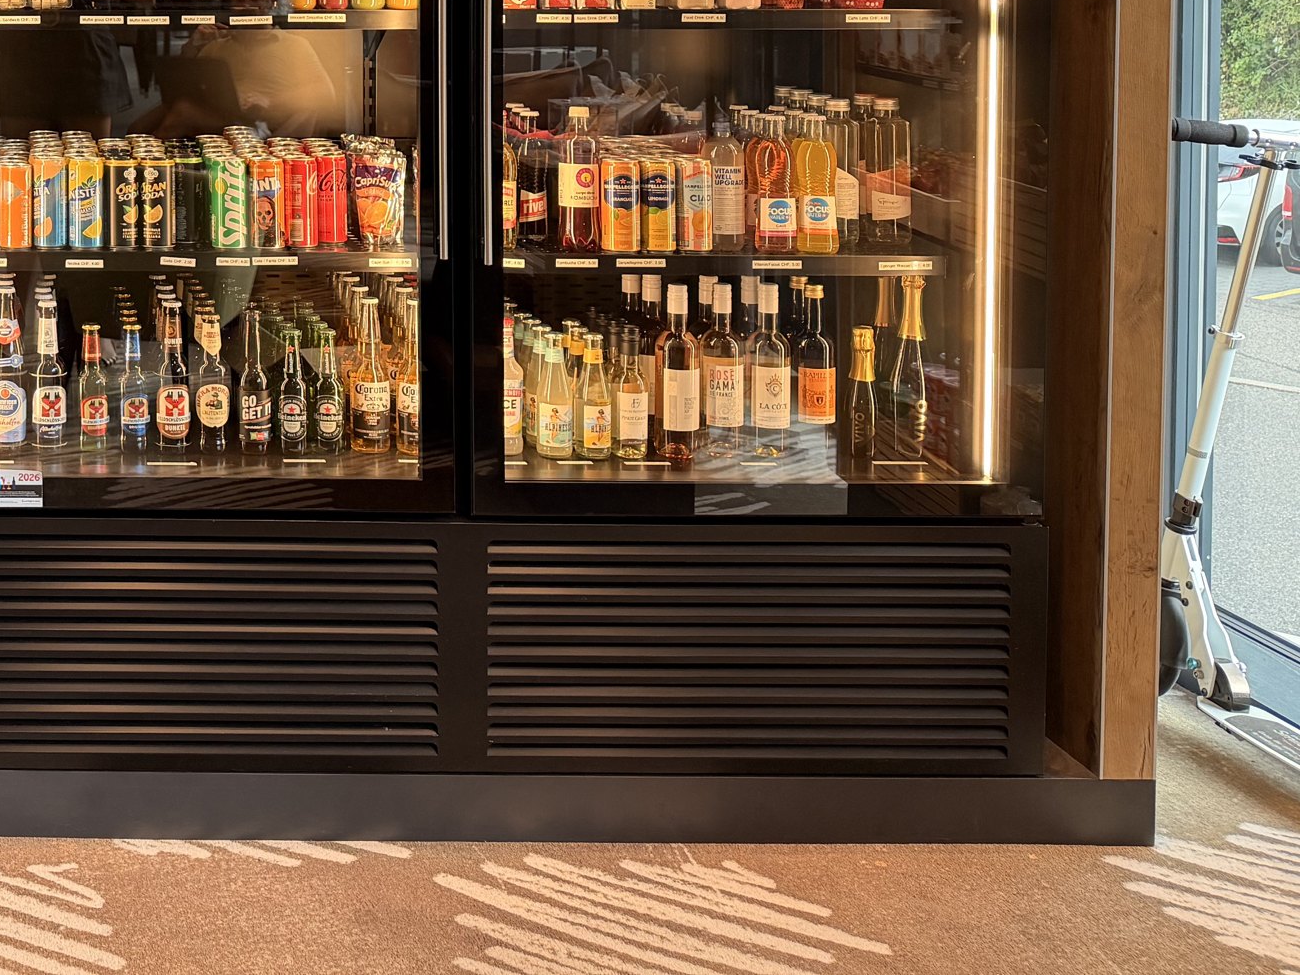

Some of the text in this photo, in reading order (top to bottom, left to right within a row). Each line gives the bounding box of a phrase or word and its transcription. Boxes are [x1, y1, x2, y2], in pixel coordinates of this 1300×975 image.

[69, 188, 101, 200] NESTEA
[115, 182, 138, 195] ORA
[118, 191, 139, 202] SOD
[141, 191, 165, 200] SODA
[220, 159, 247, 245] Sprite
[710, 368, 735, 381] ROSÉ
[355, 383, 389, 395] Corona
[242, 395, 257, 408] GO
[364, 394, 383, 402] Extra
[503, 399, 517, 409] CE
[242, 406, 263, 420] GET
[915, 400, 928, 442] VIVO
[855, 412, 865, 443] VIVO
[18, 473, 41, 482] 2026
